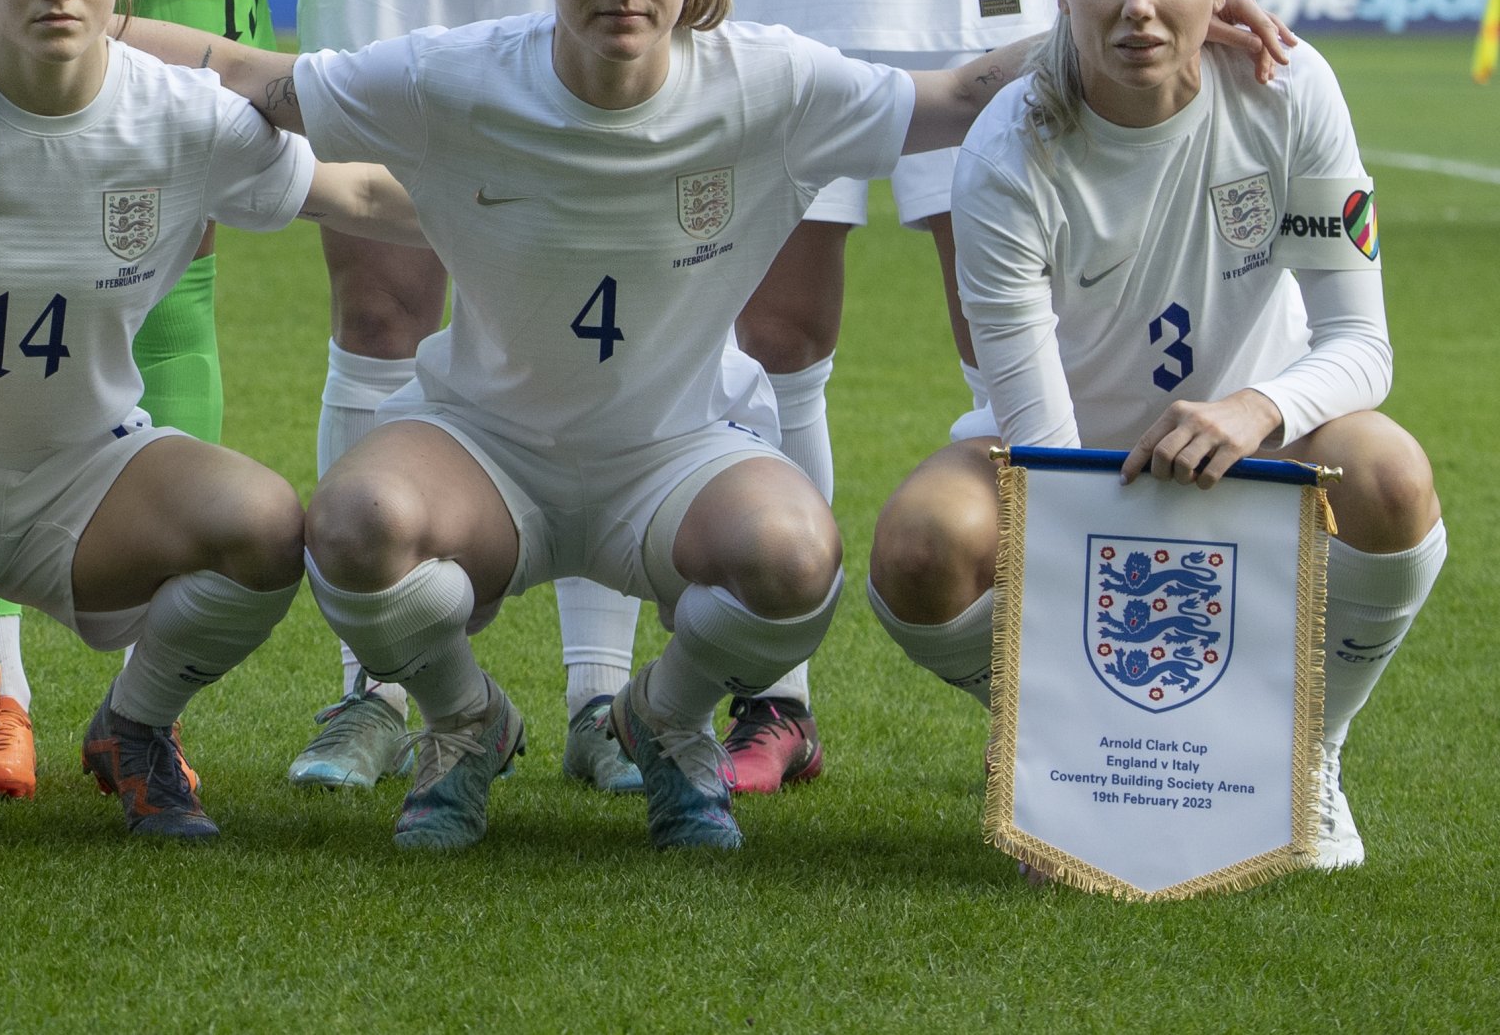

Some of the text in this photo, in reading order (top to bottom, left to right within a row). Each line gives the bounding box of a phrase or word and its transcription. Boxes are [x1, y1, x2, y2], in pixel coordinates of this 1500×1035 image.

[1281, 213, 1341, 238] #ONE
[696, 242, 718, 254] ITALY
[1243, 250, 1266, 264] ITALY
[673, 260, 681, 268] 19
[682, 249, 719, 267] FEBRUARY
[118, 264, 139, 277] ITALY
[96, 280, 104, 289] 19
[105, 273, 142, 289] FEBRUARY
[571, 275, 624, 363] 4
[1149, 303, 1193, 392] 3
[1099, 737, 1208, 755] Arnold Clark Cup
[1106, 755, 1200, 774] England v Italy
[1050, 770, 1255, 794] Coventry Building Society Arena
[1092, 791, 1212, 809] 19th February 2023
